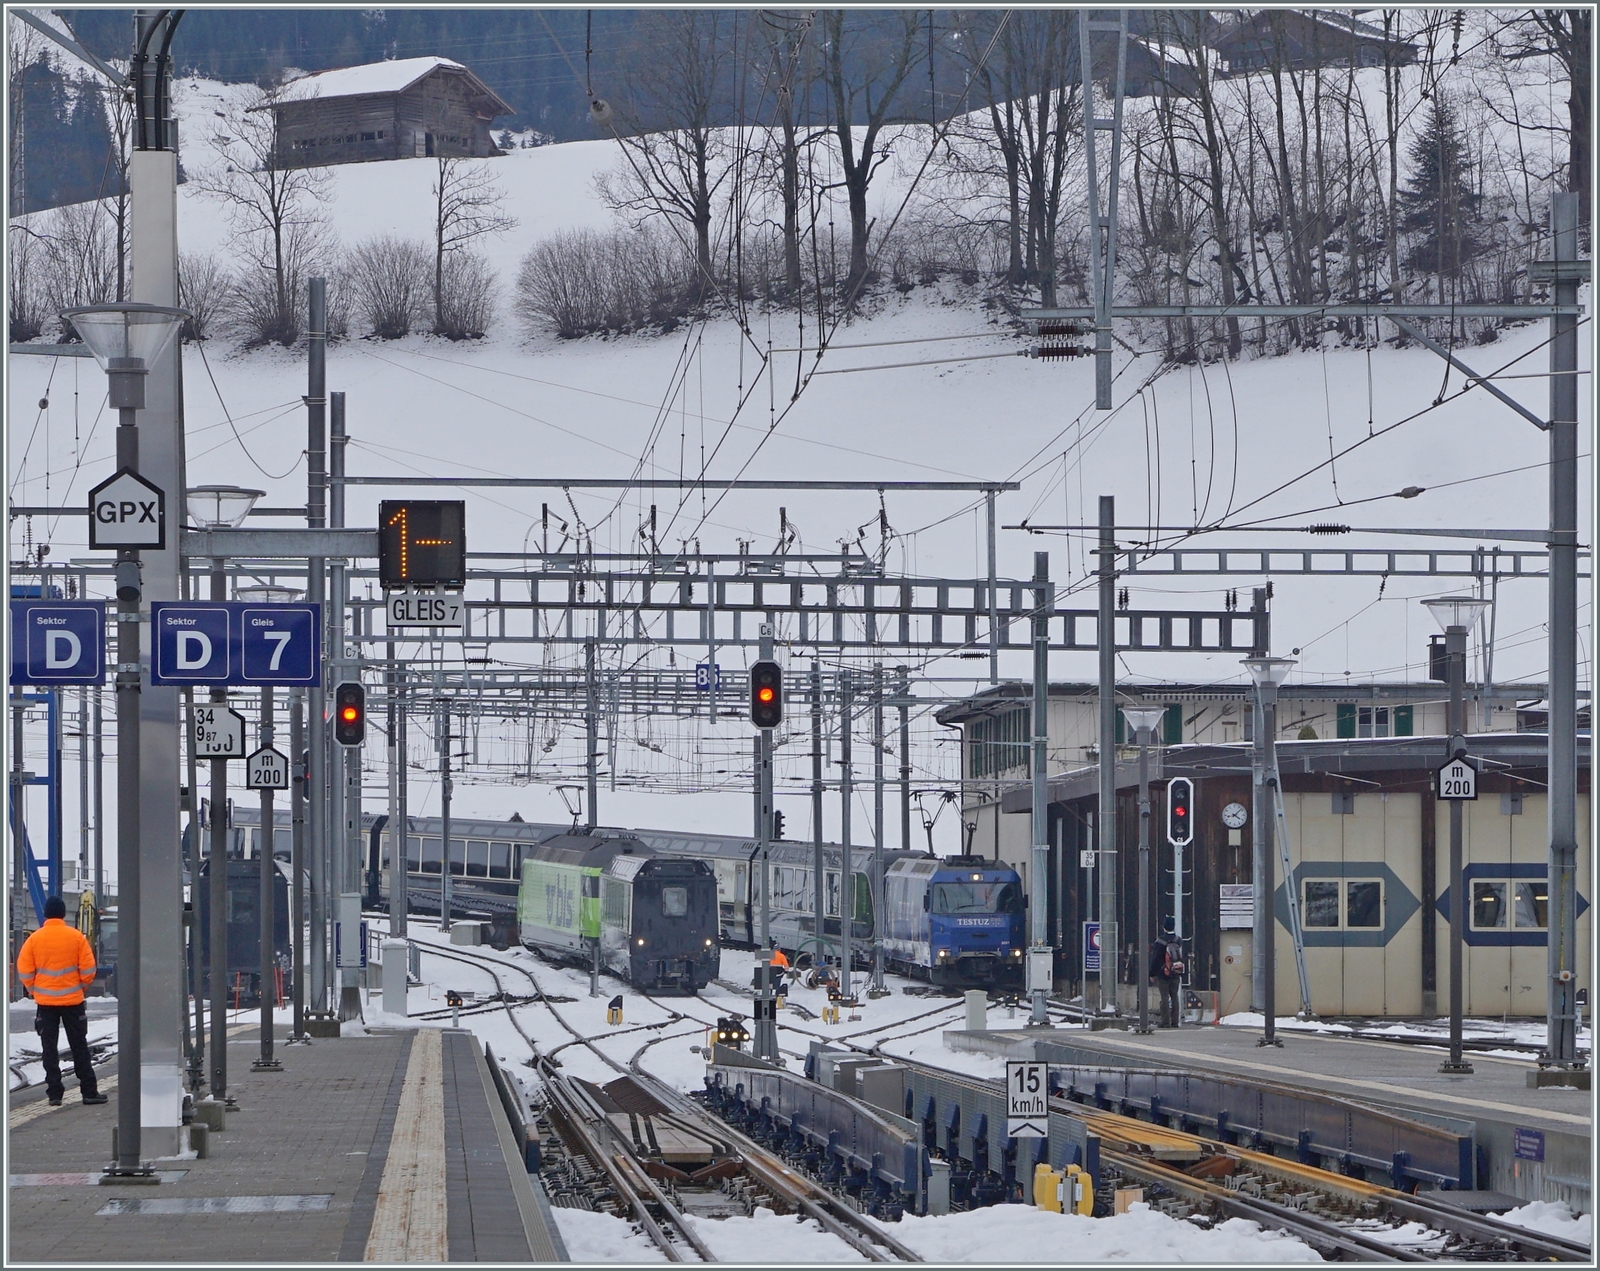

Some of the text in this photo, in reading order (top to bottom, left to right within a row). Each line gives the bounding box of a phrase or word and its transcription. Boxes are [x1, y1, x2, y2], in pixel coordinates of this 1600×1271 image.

[97, 501, 157, 524] GPX
[393, 599, 459, 621] GLEIS 7
[37, 616, 67, 625] Sektor
[166, 617, 197, 626] Sektor
[251, 618, 275, 627] Gleis
[45, 630, 82, 670] D
[176, 630, 213, 670] D
[263, 631, 291, 671] 7
[345, 647, 357, 658] C7
[196, 708, 215, 725] 34
[261, 755, 273, 767] m
[254, 769, 281, 784] 200
[1452, 766, 1463, 778] m
[1445, 780, 1470, 795] 200
[957, 918, 990, 926] TESTUZ
[1014, 1066, 1040, 1093] 15
[1011, 1096, 1044, 1113] km/h
